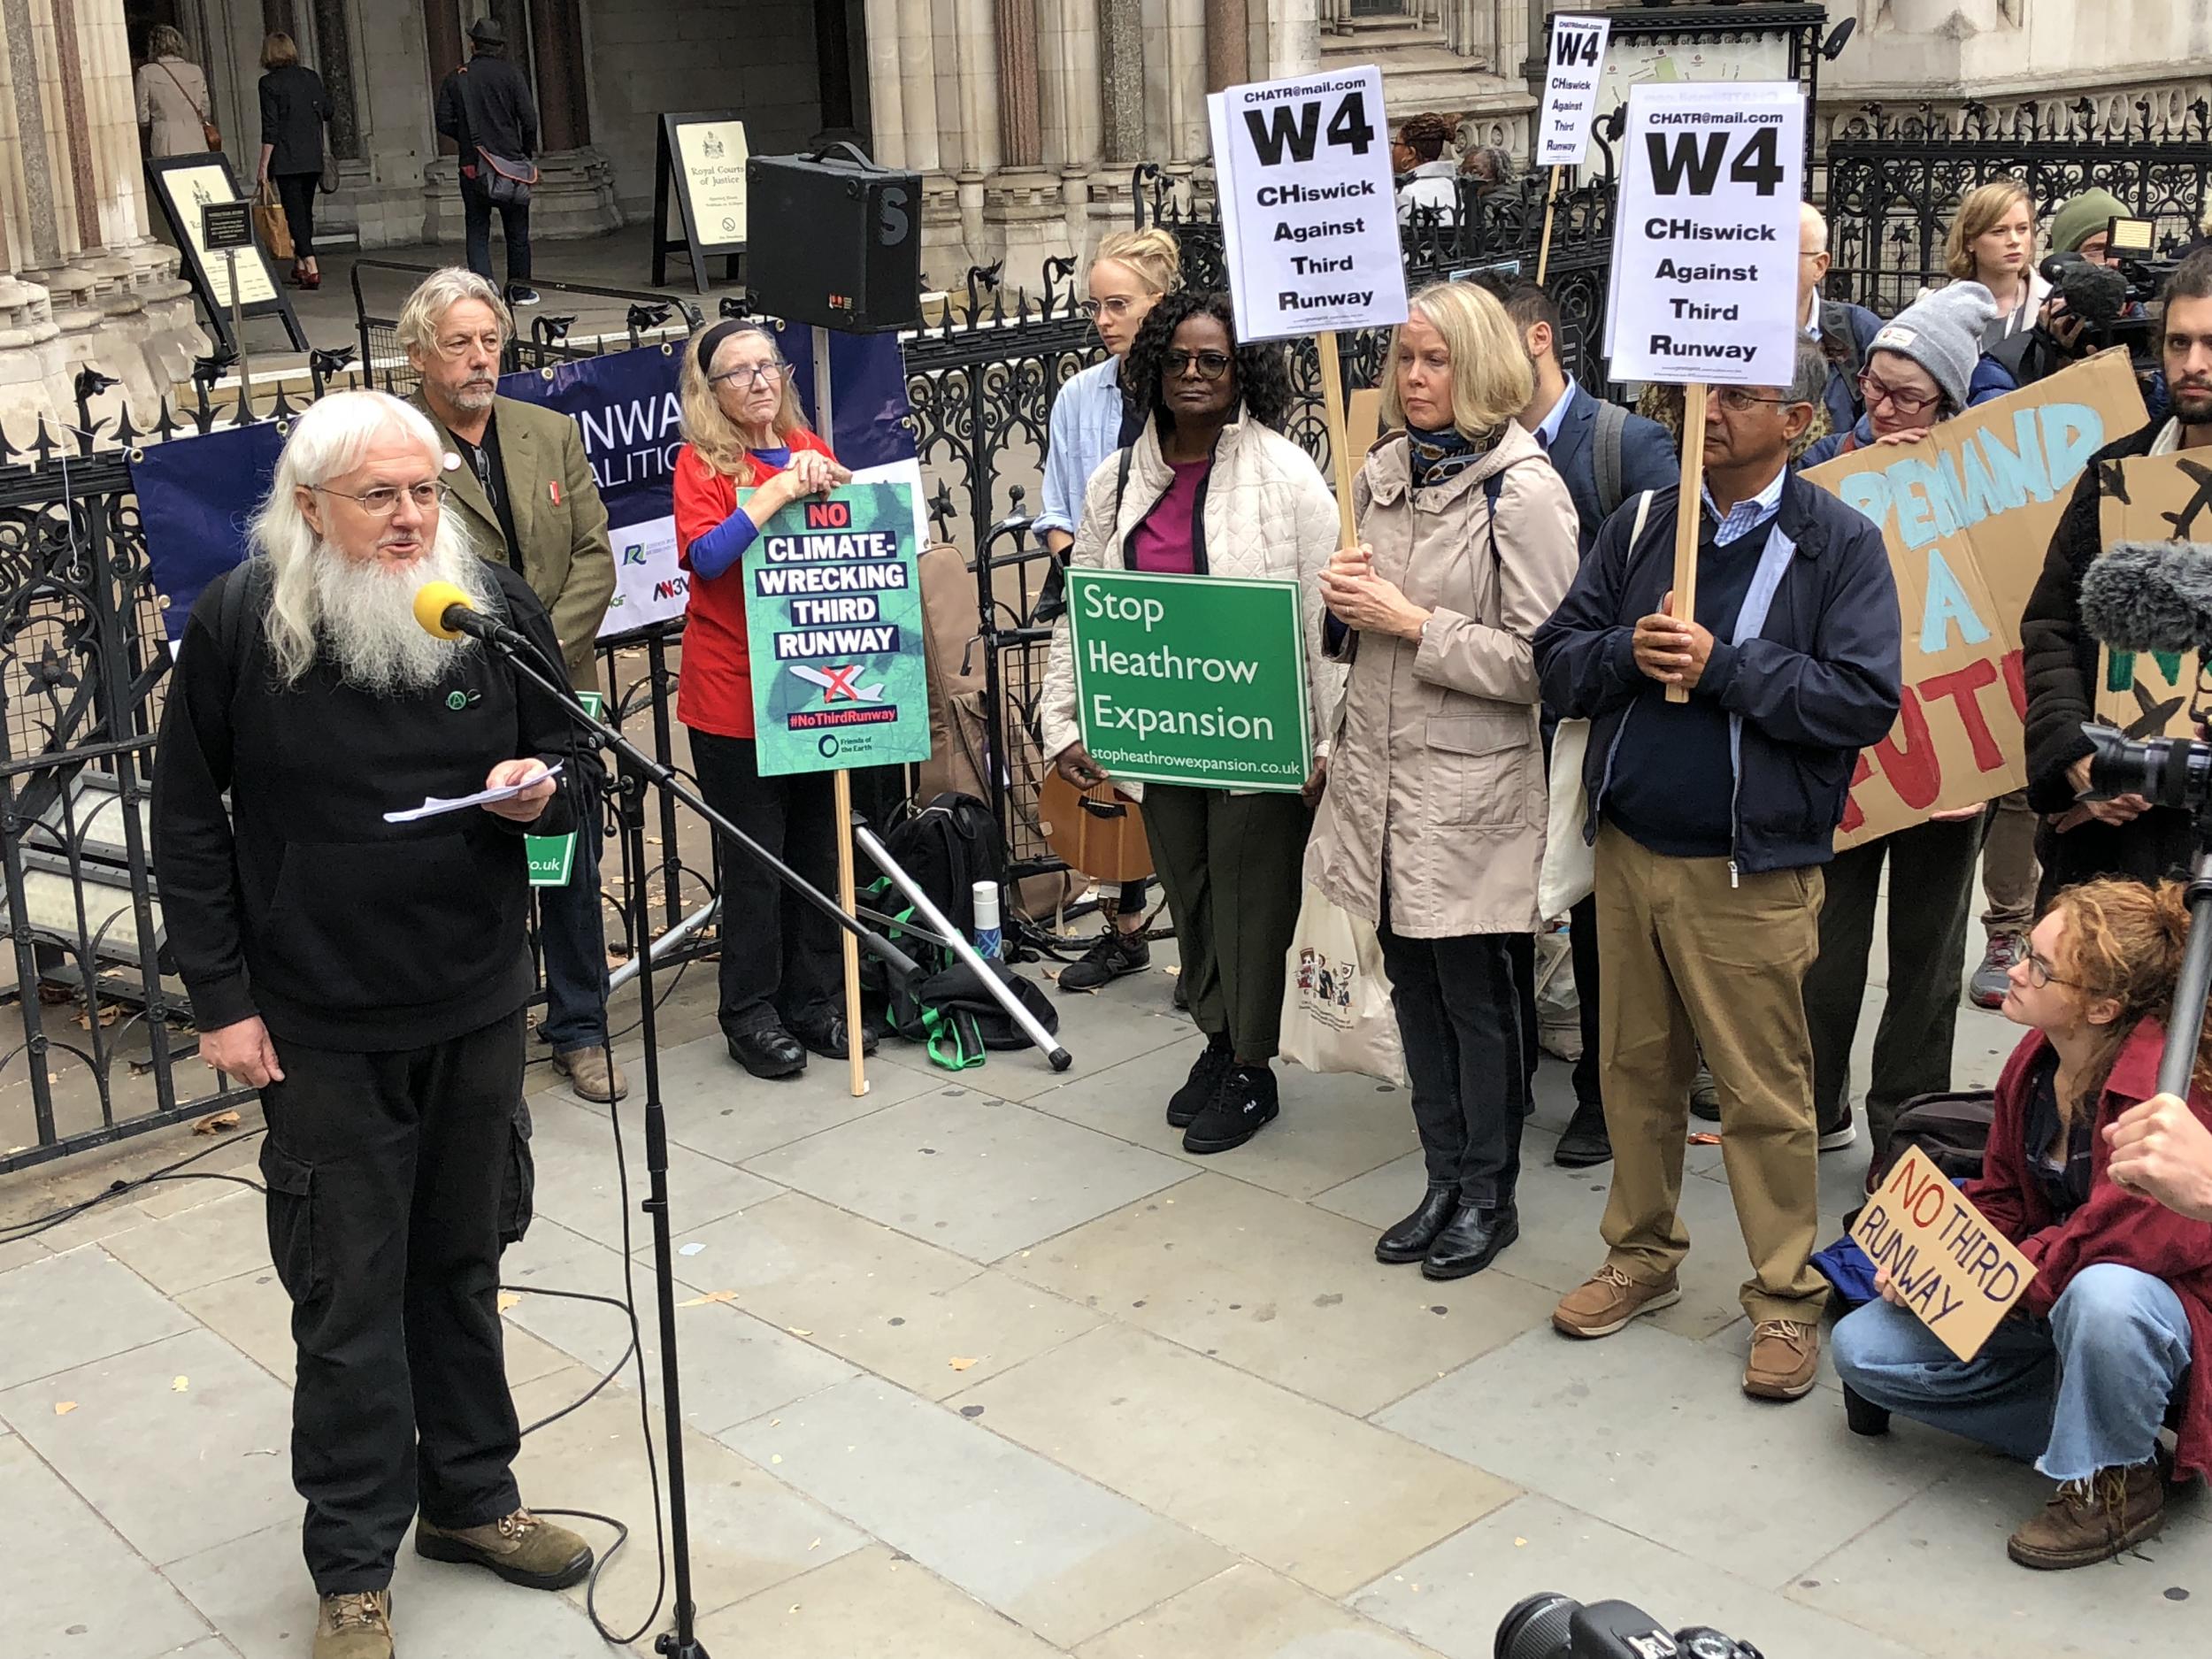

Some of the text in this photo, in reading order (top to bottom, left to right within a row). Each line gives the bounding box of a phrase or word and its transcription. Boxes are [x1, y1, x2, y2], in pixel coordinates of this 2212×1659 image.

[1556, 32, 1599, 67] W4
[1244, 78, 1366, 103] CHATR@mail.com
[1551, 77, 1591, 90] CHiswick
[1552, 98, 1583, 112] Against
[1648, 112, 1784, 125] CHATR@mail.com
[1242, 92, 1375, 167] W4
[1555, 119, 1575, 132] Third
[1546, 139, 1577, 152] Runway
[691, 166, 715, 176] Royal
[1645, 127, 1785, 196] W4
[712, 175, 740, 187] Justice
[1256, 180, 1376, 207] CHiswick
[1273, 218, 1365, 242] Against
[1644, 218, 1777, 241] CHiswick
[1291, 255, 1354, 275] Third
[1655, 258, 1759, 283] Against
[1278, 289, 1374, 311] Runway
[1670, 298, 1739, 320] Third
[1649, 334, 1757, 362] Runway
[569, 392, 682, 454] NWA
[1840, 403, 2104, 550] DEMAND
[809, 503, 848, 527] NO
[767, 534, 895, 561] CLIMATE-
[757, 564, 904, 594] WRECKING
[793, 597, 876, 624] THIRD
[1083, 583, 1164, 632] Stop
[1918, 549, 1992, 654] A
[779, 627, 895, 657] RUNWAY
[1087, 639, 1259, 685] Heathrow
[789, 708, 895, 727] #NoThirdRunway
[1093, 694, 1274, 741] Expansion
[1091, 748, 1301, 776] stopheathrowexpansion.co.uk
[1889, 1157, 2019, 1302] NO THIRD
[1858, 1205, 1964, 1325] RUNWAY
